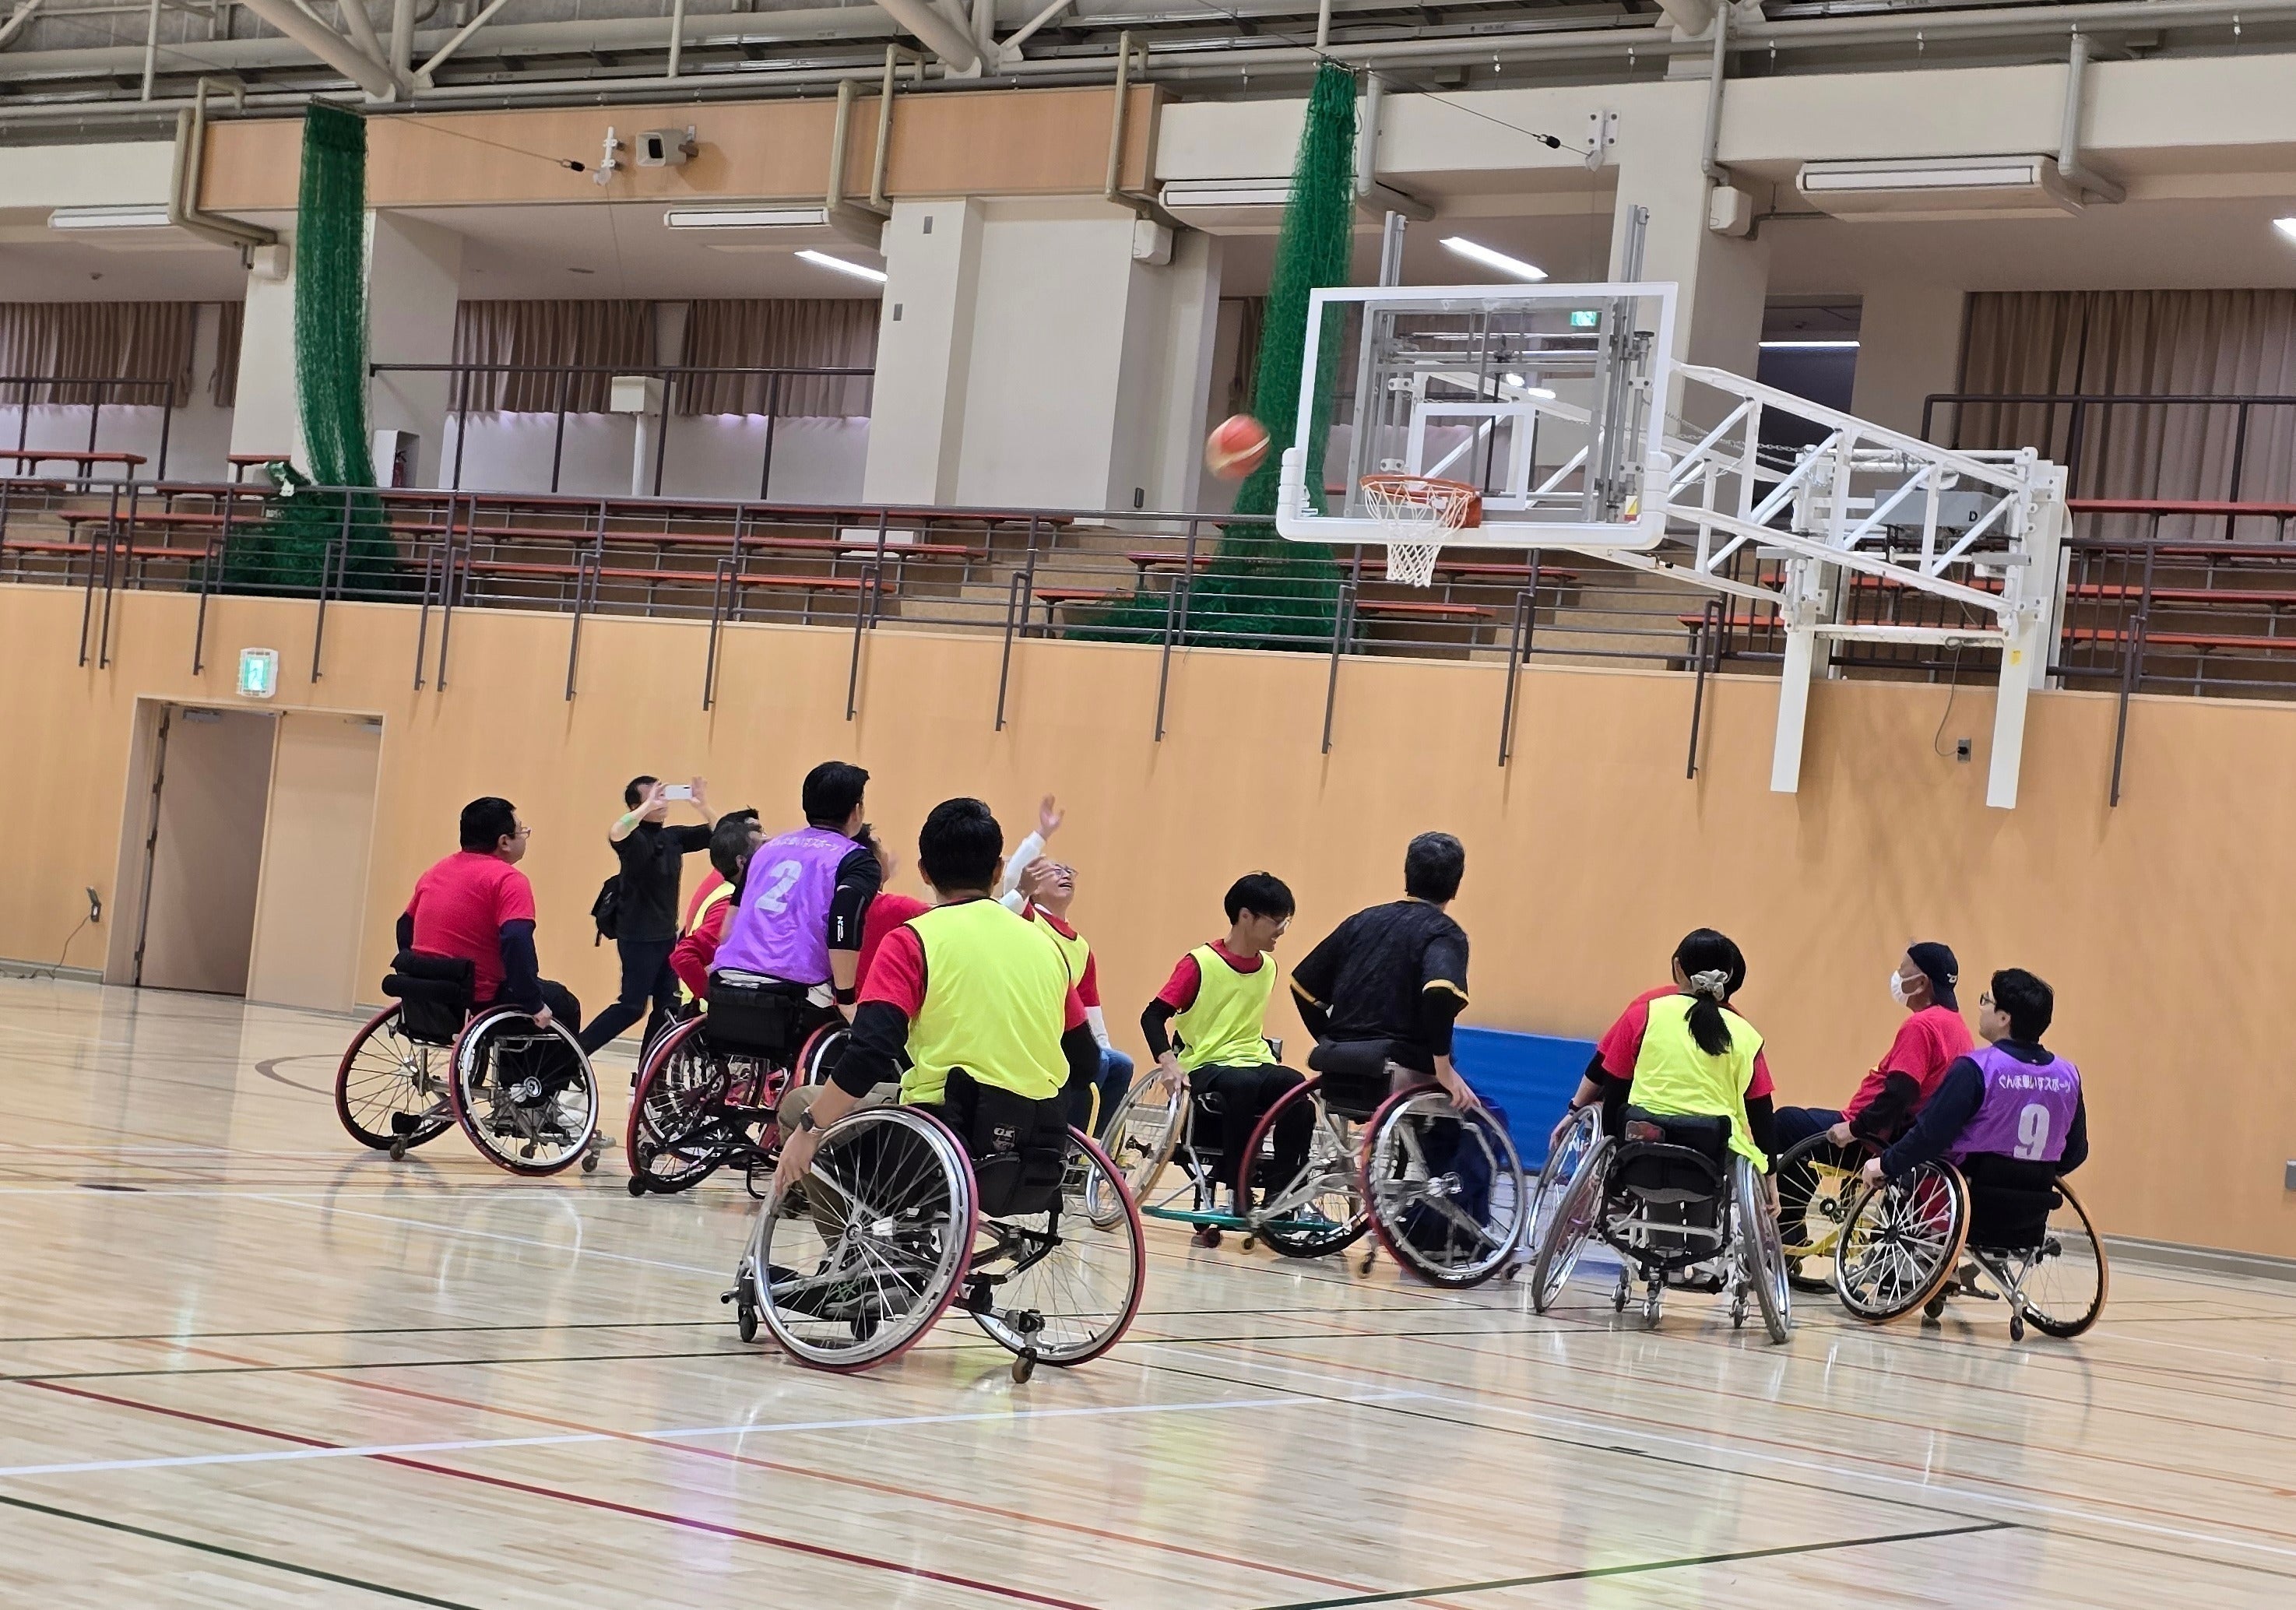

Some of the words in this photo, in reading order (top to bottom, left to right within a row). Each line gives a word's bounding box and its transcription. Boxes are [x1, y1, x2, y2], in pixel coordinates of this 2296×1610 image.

[1969, 511, 1978, 522] D
[754, 859, 802, 914] 2
[2013, 1103, 2050, 1161] 9
